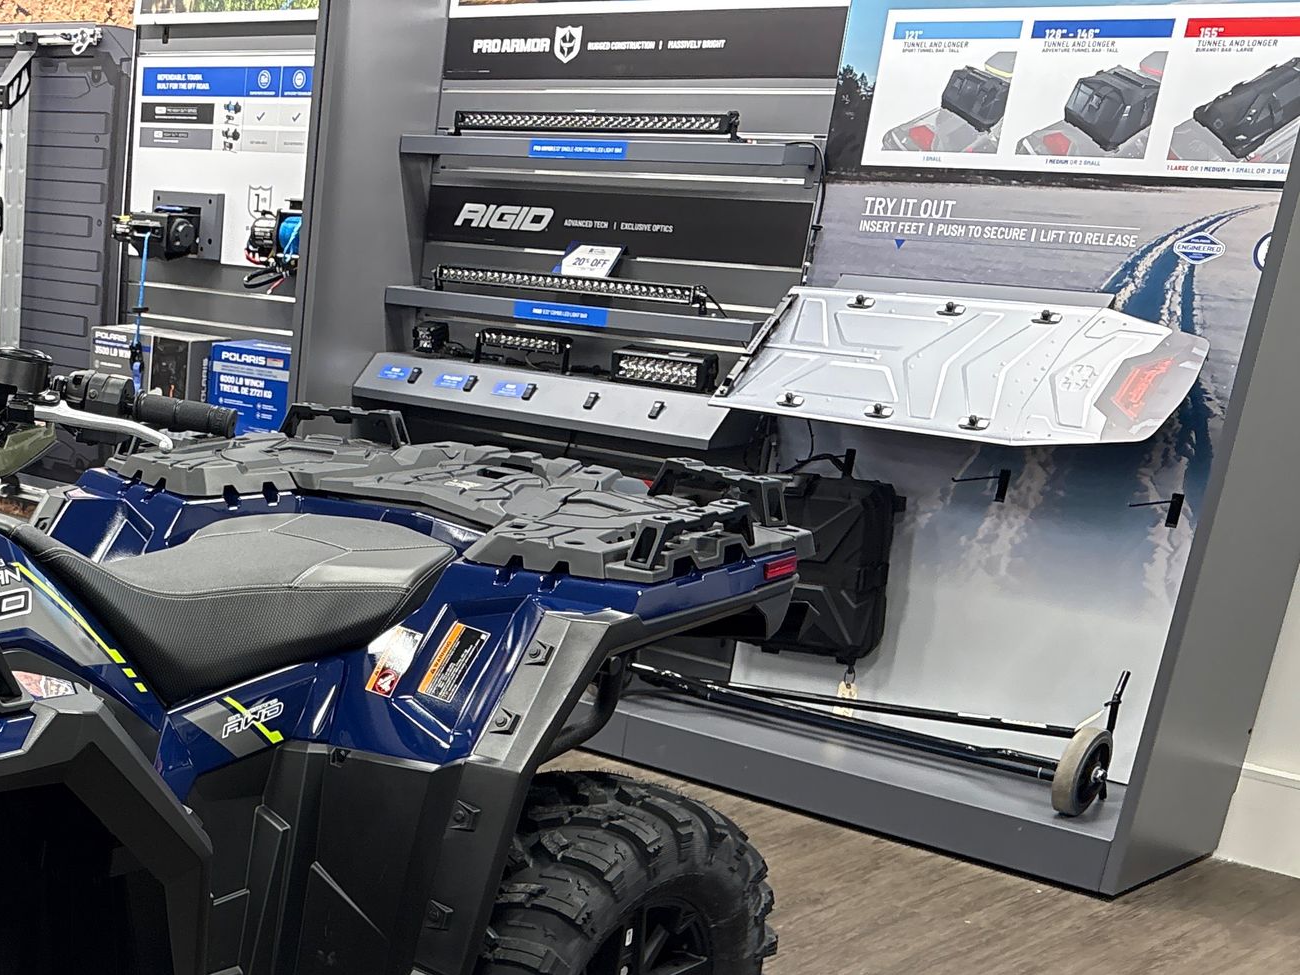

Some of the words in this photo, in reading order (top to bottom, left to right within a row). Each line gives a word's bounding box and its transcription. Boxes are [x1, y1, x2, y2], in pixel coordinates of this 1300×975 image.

[1200, 27, 1224, 38] 155"
[611, 40, 655, 50] CONSTRUCTION
[668, 40, 701, 49] MASSIVELY
[702, 40, 725, 48] BRIGHT
[1044, 40, 1069, 48] TUNNEL
[864, 196, 896, 216] TRY
[900, 198, 917, 217] IT
[920, 199, 956, 219] OUT
[454, 203, 554, 232] RIGID
[564, 219, 593, 228] ADVANCED
[594, 220, 608, 229] TECH
[620, 222, 651, 231] EXCLUSIVE
[652, 224, 674, 233] OPTICS
[859, 220, 896, 233] INSERT
[897, 222, 925, 234] FEET
[936, 223, 967, 236] PUSH
[968, 225, 982, 237] TO
[983, 226, 1027, 241] SECURE
[1040, 229, 1065, 243] LIFT
[1068, 231, 1083, 244] TO
[1084, 232, 1137, 247] RELEASE
[1177, 244, 1221, 253] ENGINEERED
[590, 259, 610, 268] OFF
[95, 331, 127, 342] POLARIS
[221, 351, 266, 365] POLARIS
[244, 378, 265, 388] WINCH
[220, 383, 240, 394] TREUIL
[241, 386, 249, 395] DE
[434, 641, 452, 668] WARNING
[222, 702, 284, 739] AWD
